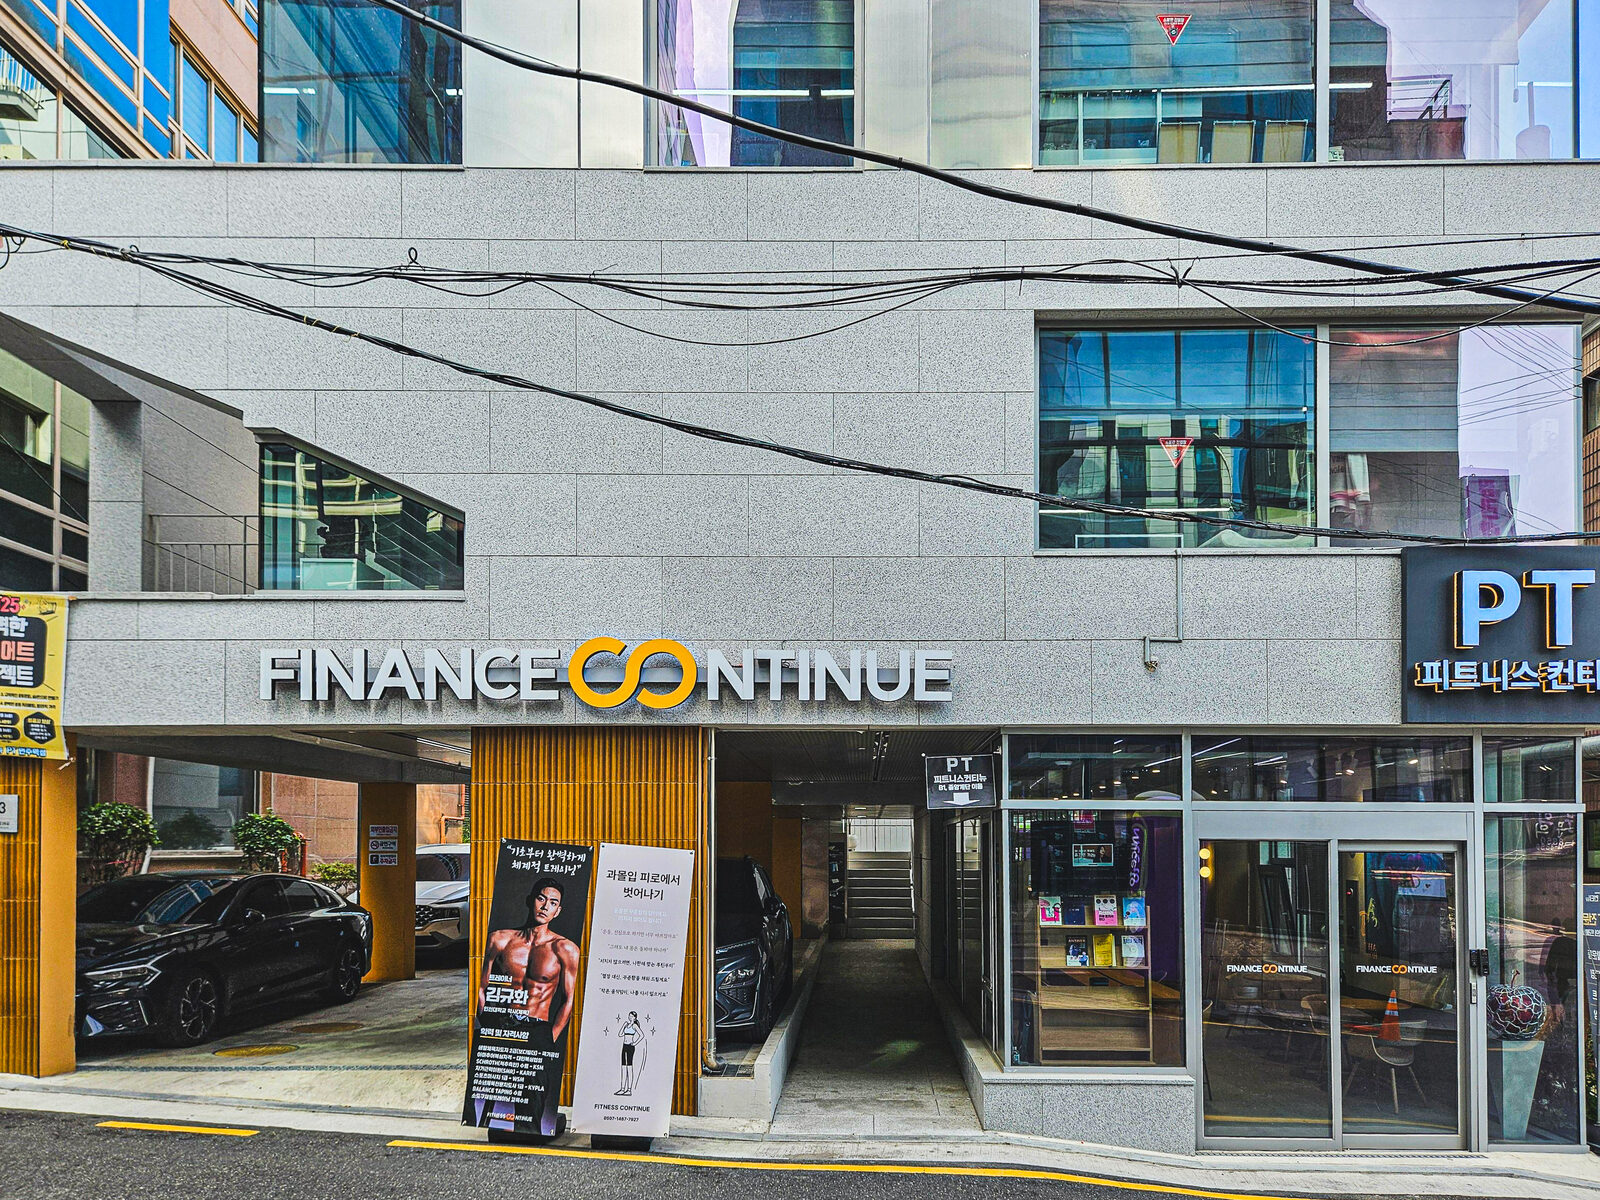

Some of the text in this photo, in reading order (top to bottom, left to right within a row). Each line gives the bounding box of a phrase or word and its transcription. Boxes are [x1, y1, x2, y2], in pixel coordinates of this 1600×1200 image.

[1453, 569, 1596, 650] PT
[946, 757, 973, 772] PT
[933, 773, 988, 784] 피트니스컨티뉴
[547, 849, 586, 862] 완벽하게
[511, 860, 541, 873] 체계적
[606, 869, 681, 886] 과몰입 피로에서
[623, 887, 664, 901] 벗어나기
[488, 974, 513, 983] 트레이너
[486, 987, 529, 1006] 김규화
[594, 1103, 619, 1111] FITNESS
